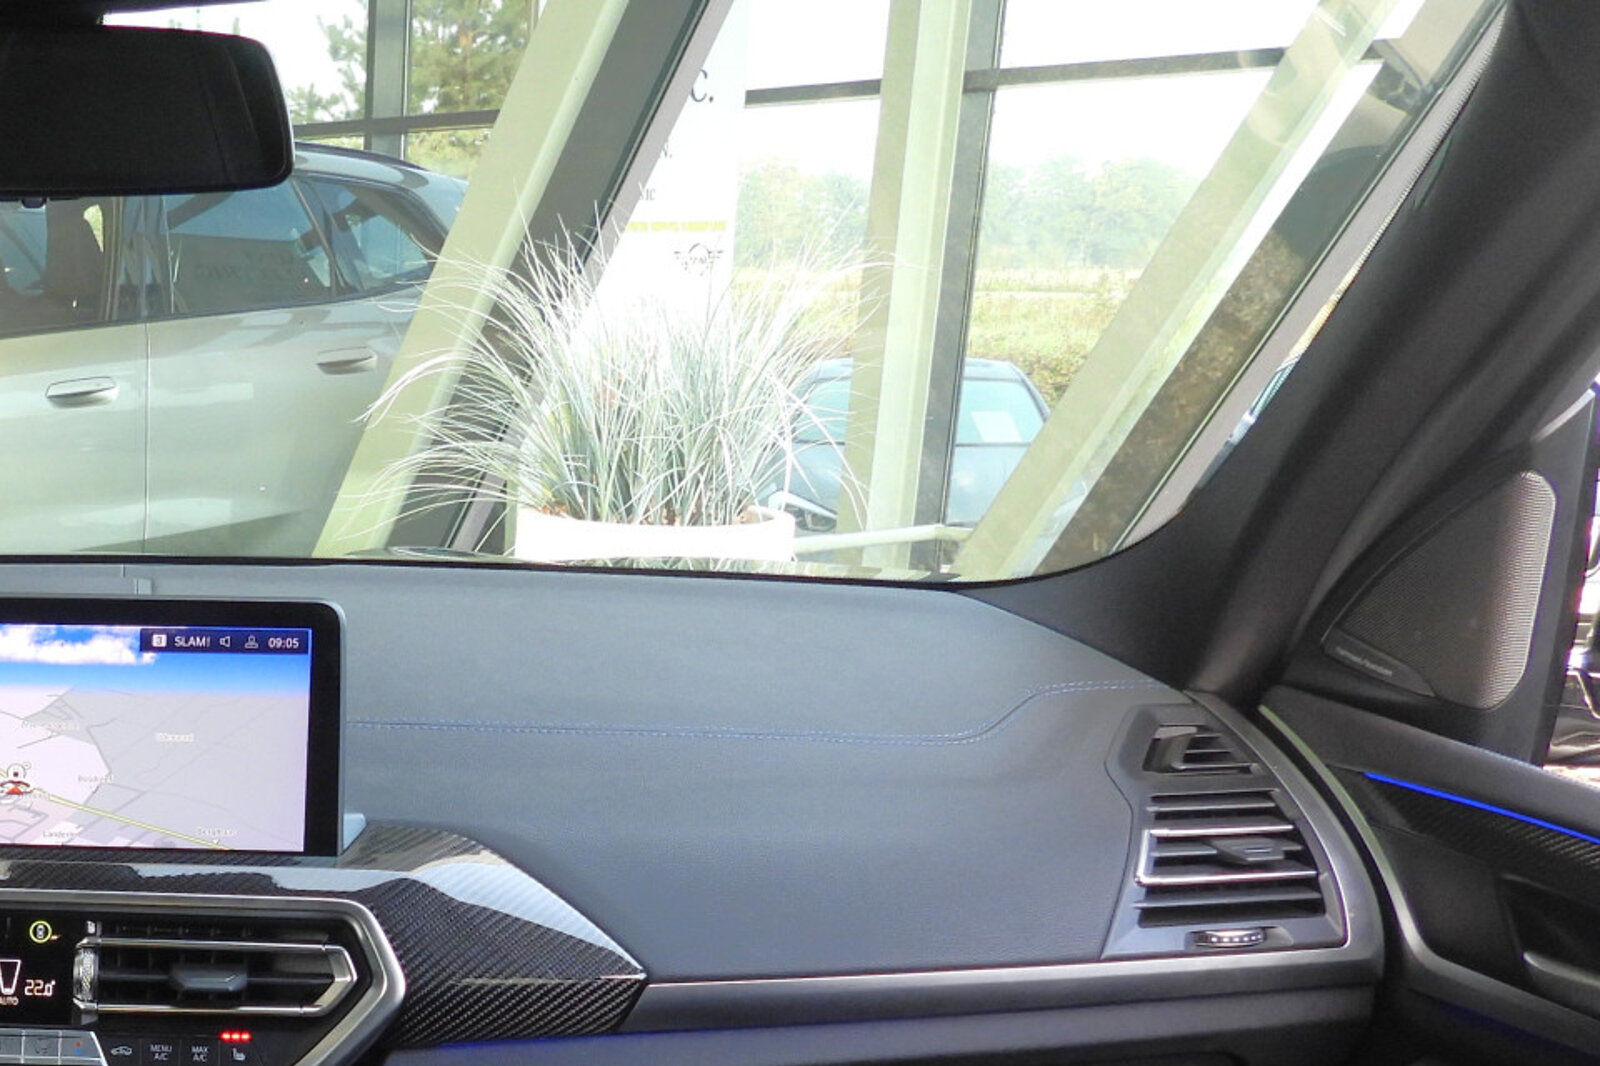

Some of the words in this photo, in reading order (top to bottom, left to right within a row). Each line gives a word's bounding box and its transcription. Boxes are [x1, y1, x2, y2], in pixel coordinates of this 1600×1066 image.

[174, 636, 211, 648] SLAM!
[268, 637, 300, 649] 09:05
[150, 1044, 173, 1052] MENU
[191, 1046, 209, 1054] MAX
[153, 1052, 169, 1061] A/C
[192, 1054, 208, 1063] A/C
